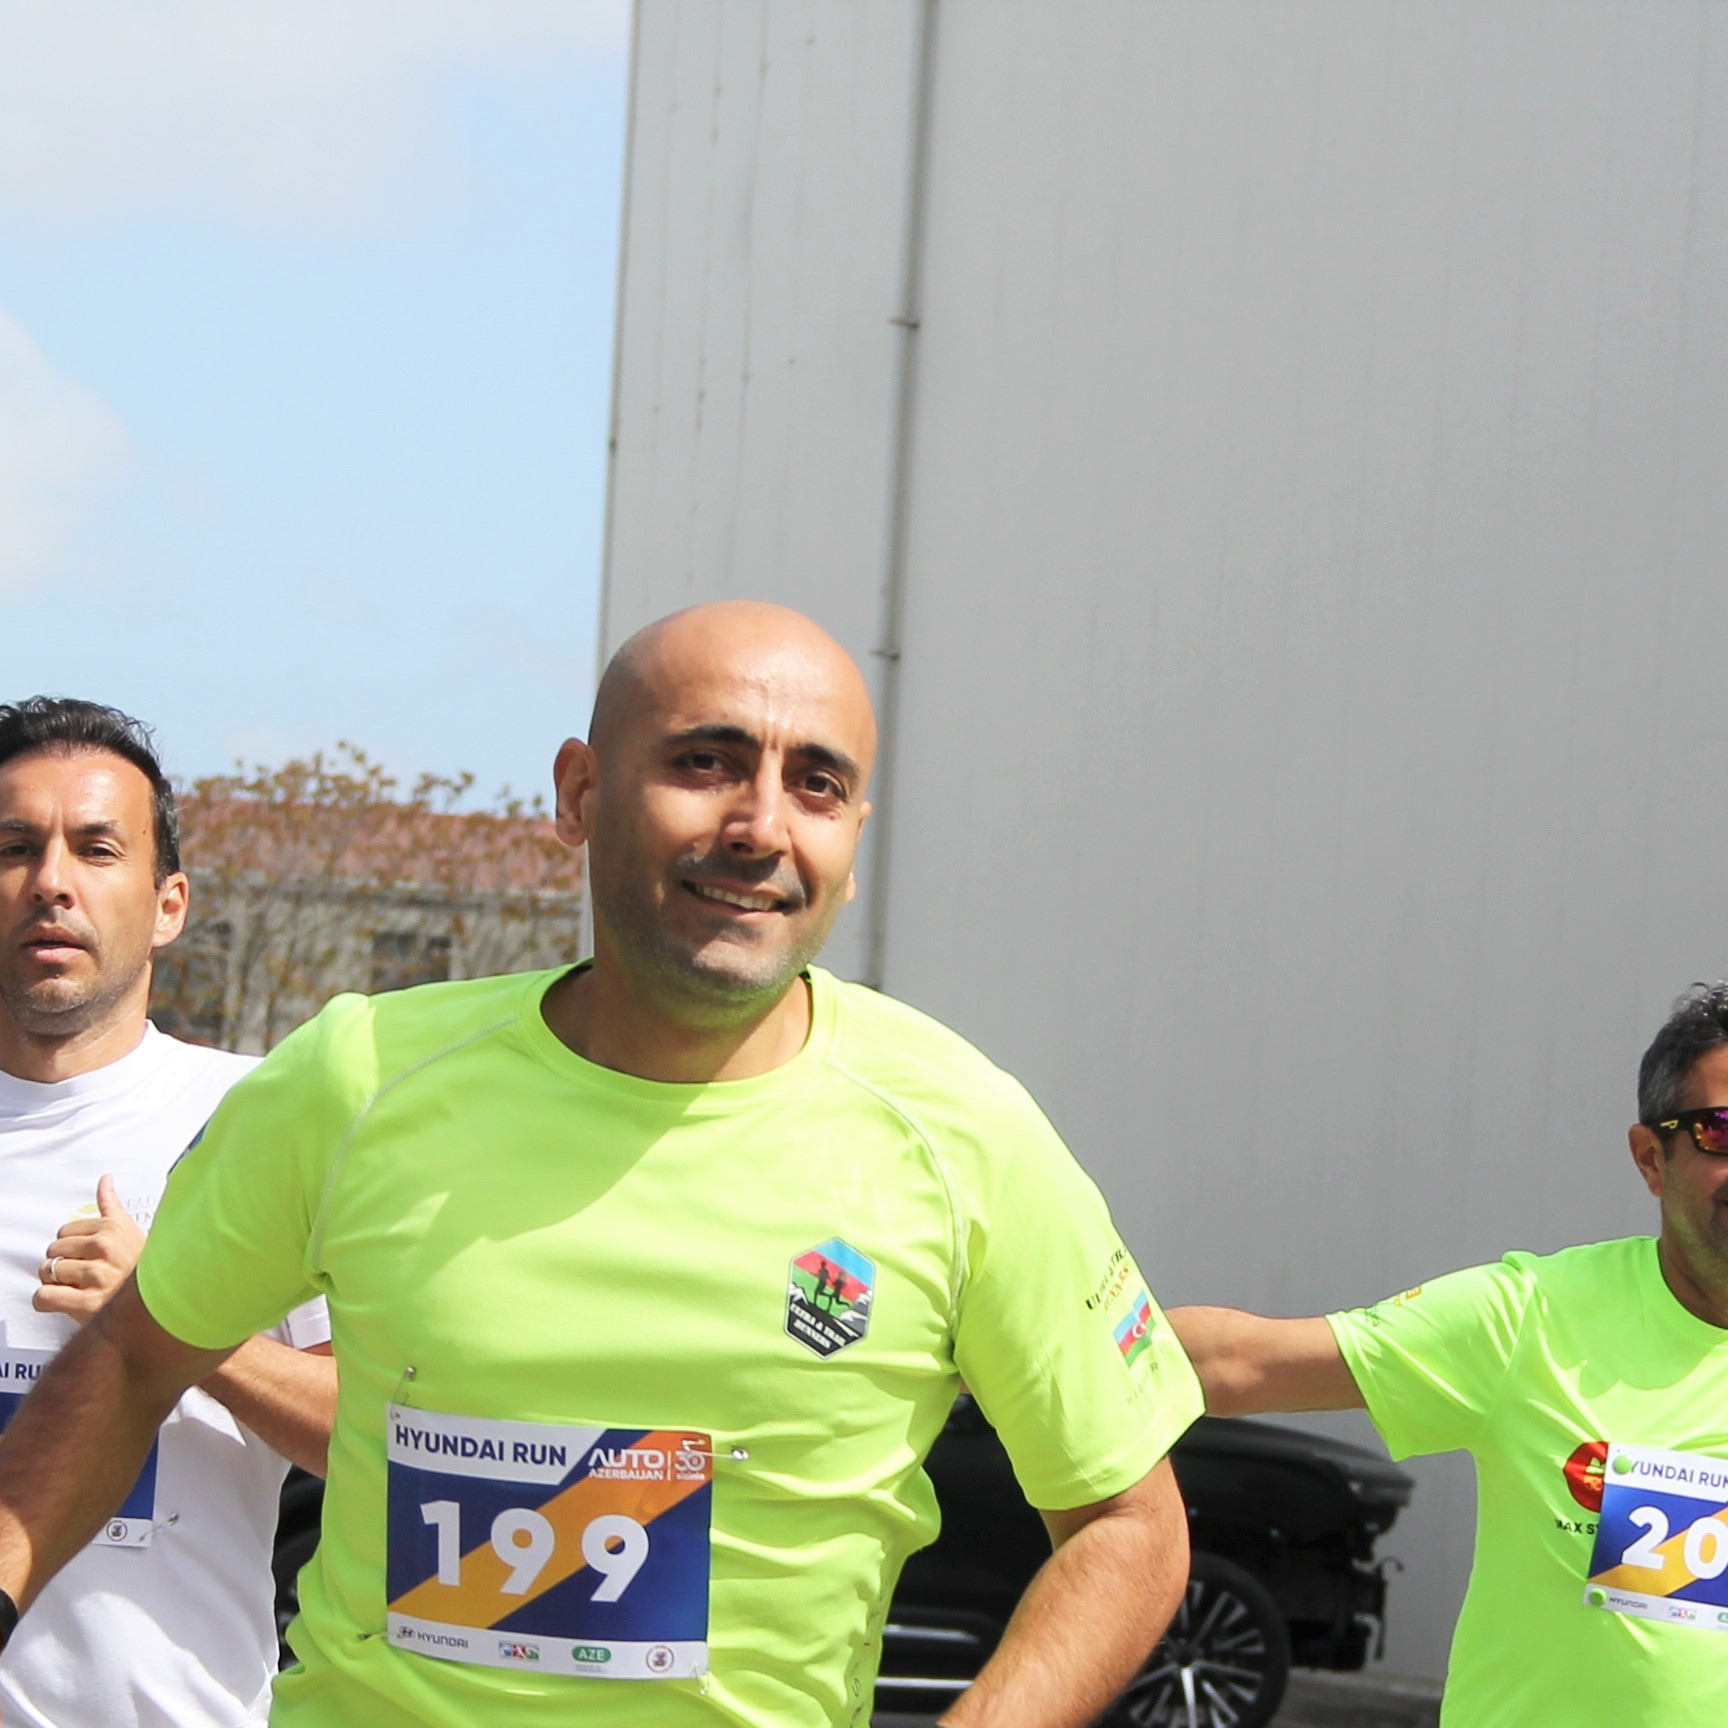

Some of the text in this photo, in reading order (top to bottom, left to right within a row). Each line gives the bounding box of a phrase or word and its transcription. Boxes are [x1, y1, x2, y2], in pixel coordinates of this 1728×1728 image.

[15, 1364, 47, 1381] RU
[395, 1423, 567, 1467] HYUNDAI RUN
[588, 1448, 665, 1469] AUTO
[1622, 1459, 1694, 1483] YUNDAI
[420, 1500, 649, 1602] 199
[417, 1631, 469, 1649] HYUNDAI
[577, 1649, 606, 1662] AZE
